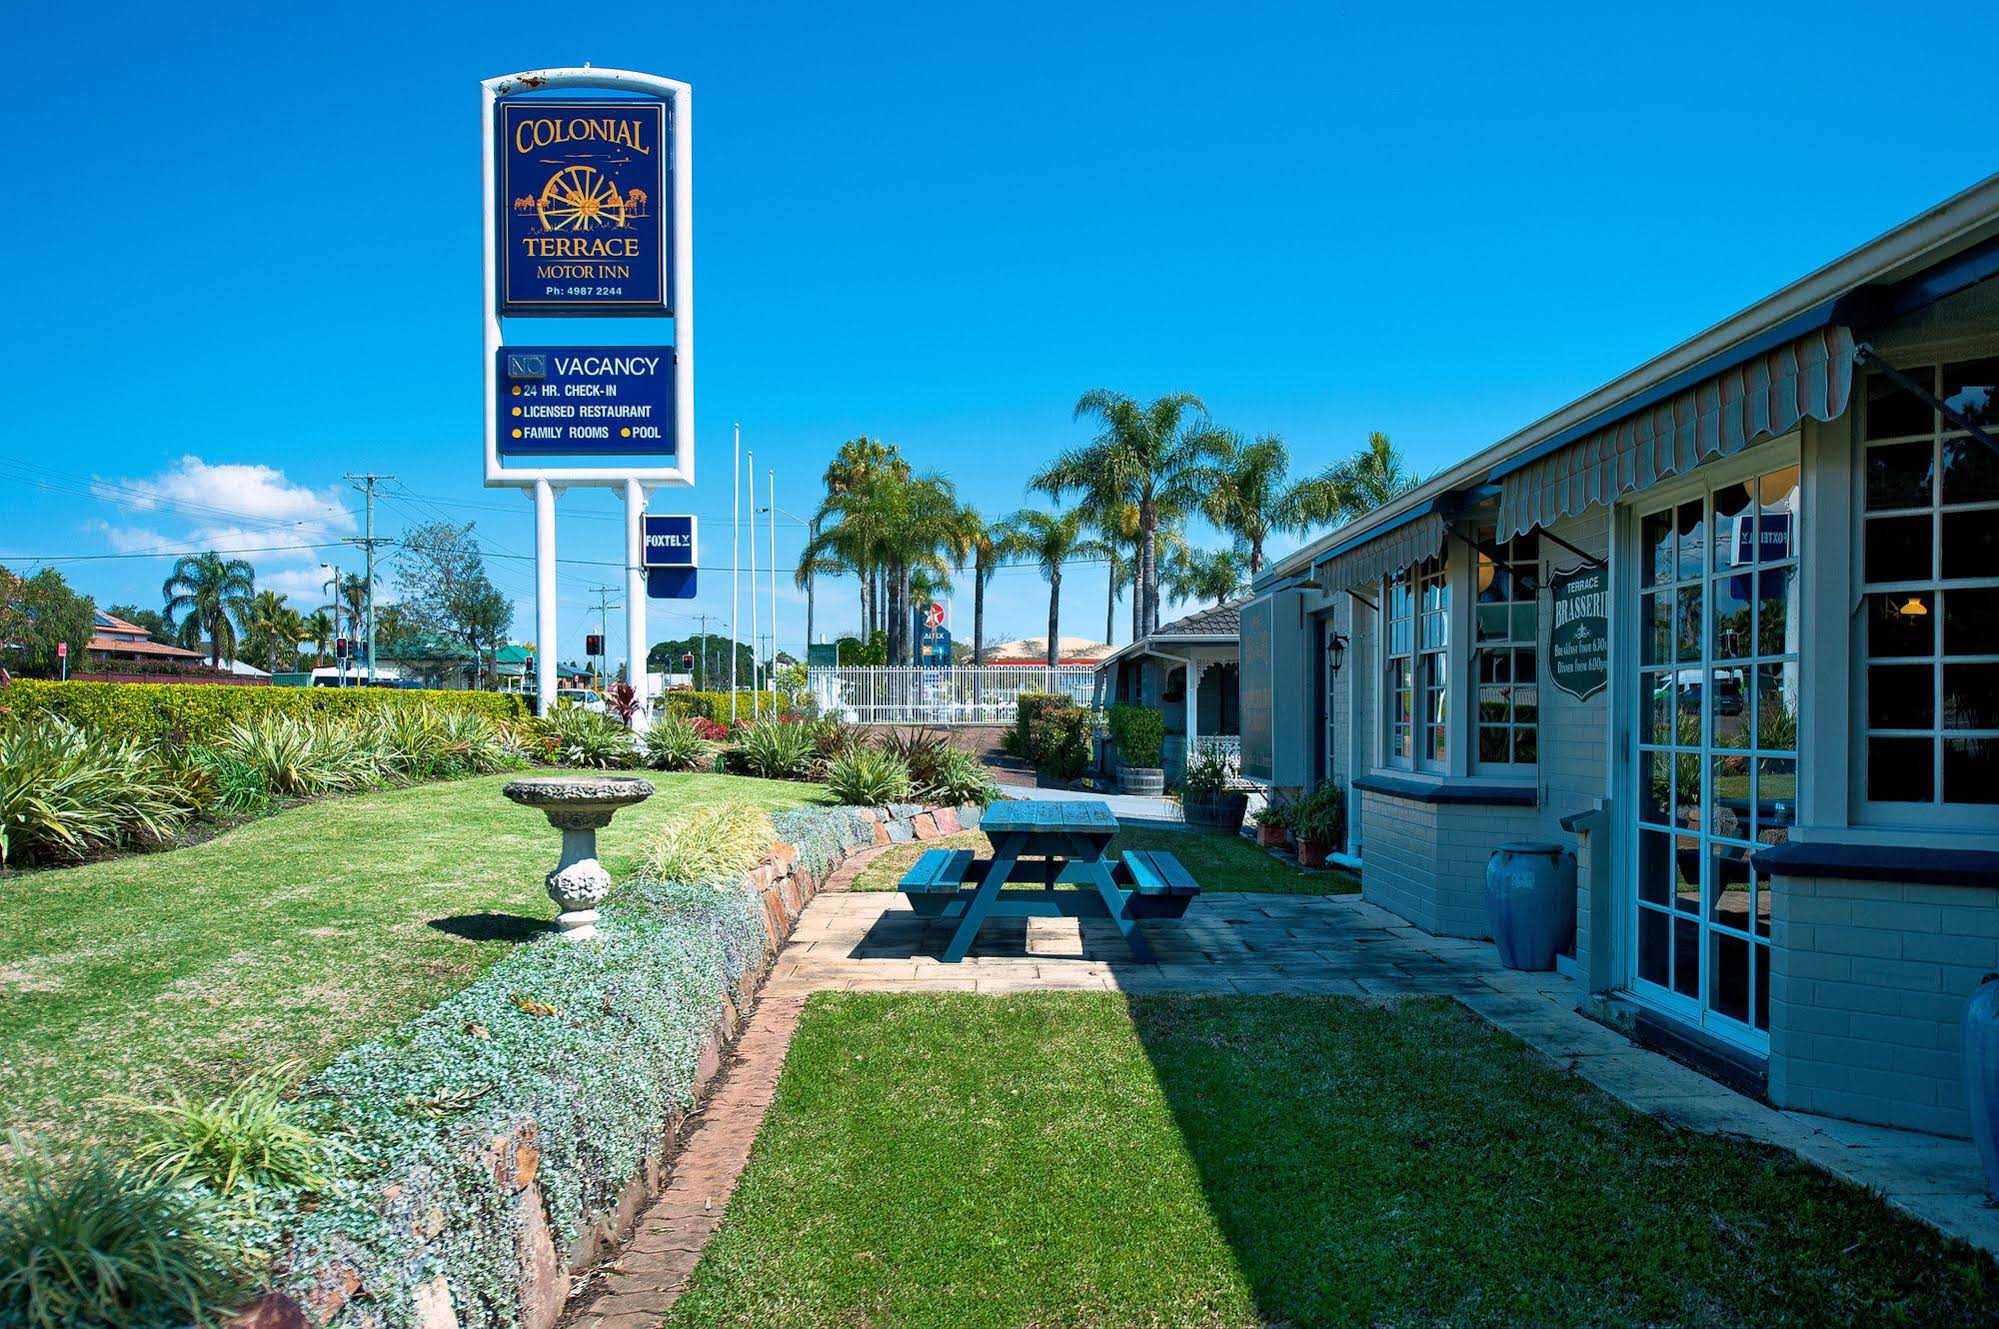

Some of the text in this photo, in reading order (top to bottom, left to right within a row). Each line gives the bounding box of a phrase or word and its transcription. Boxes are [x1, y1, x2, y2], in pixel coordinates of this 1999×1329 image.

[516, 118, 650, 155] COLONIAL
[522, 238, 640, 257] TERRACE
[537, 265, 630, 279] MOTOR INN
[546, 286, 623, 296] Ph: 4987 2244
[512, 357, 660, 376] NO VACANCY
[523, 384, 617, 397] 24 HR. CHECK-IN
[523, 405, 652, 418] LICENSED RESTAURANT
[523, 427, 610, 439] FAMILY ROOMS
[632, 426, 662, 439] POOL
[646, 534, 681, 547] FOXTEL
[1567, 576, 1599, 594] TERRACE
